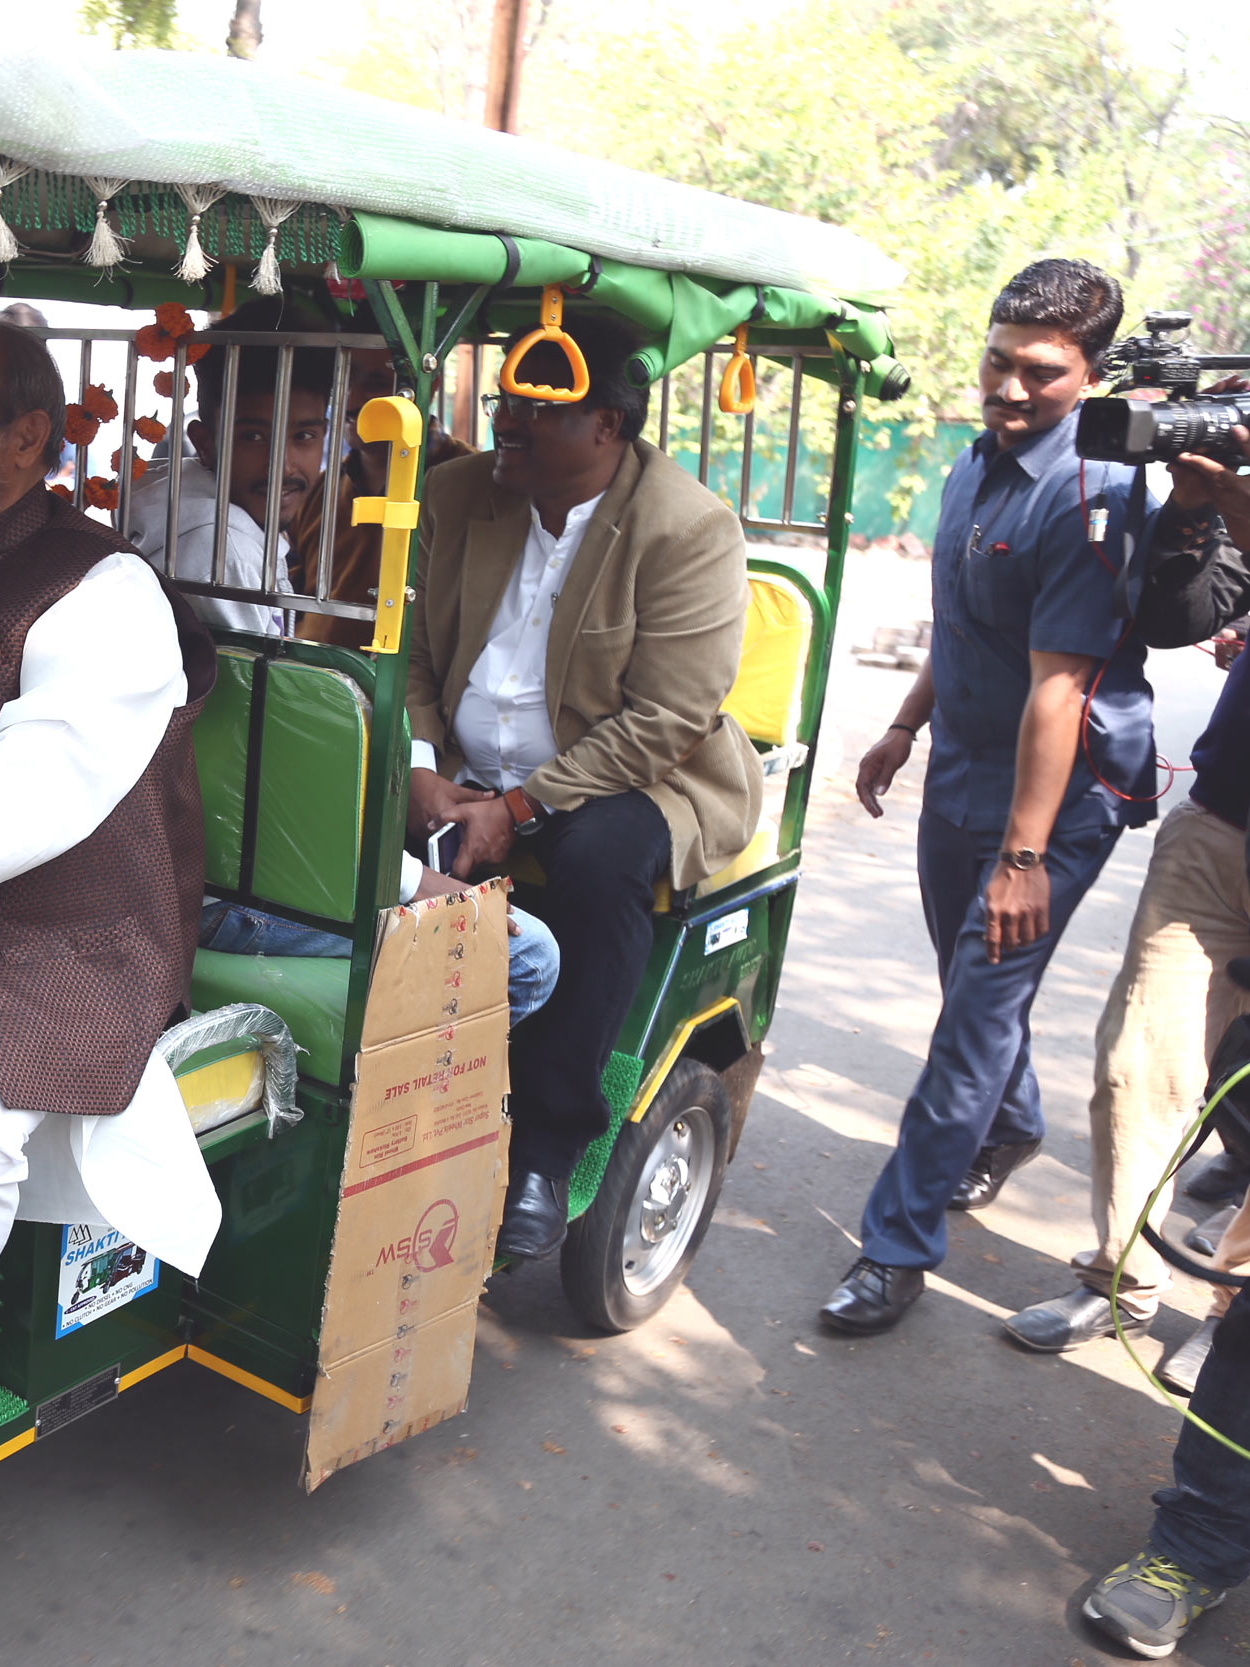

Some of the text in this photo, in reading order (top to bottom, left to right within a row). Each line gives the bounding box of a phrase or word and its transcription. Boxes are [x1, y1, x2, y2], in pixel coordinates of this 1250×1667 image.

[467, 1056, 487, 1072] NOT
[385, 1082, 410, 1100] SALE
[413, 1070, 446, 1090] RETAIL
[65, 1231, 120, 1267] SHAKTI
[66, 1279, 153, 1326] NO CLUTCH NO GEAR NO POLLUTION
[88, 1282, 133, 1308] NO DIESEL NO CNG
